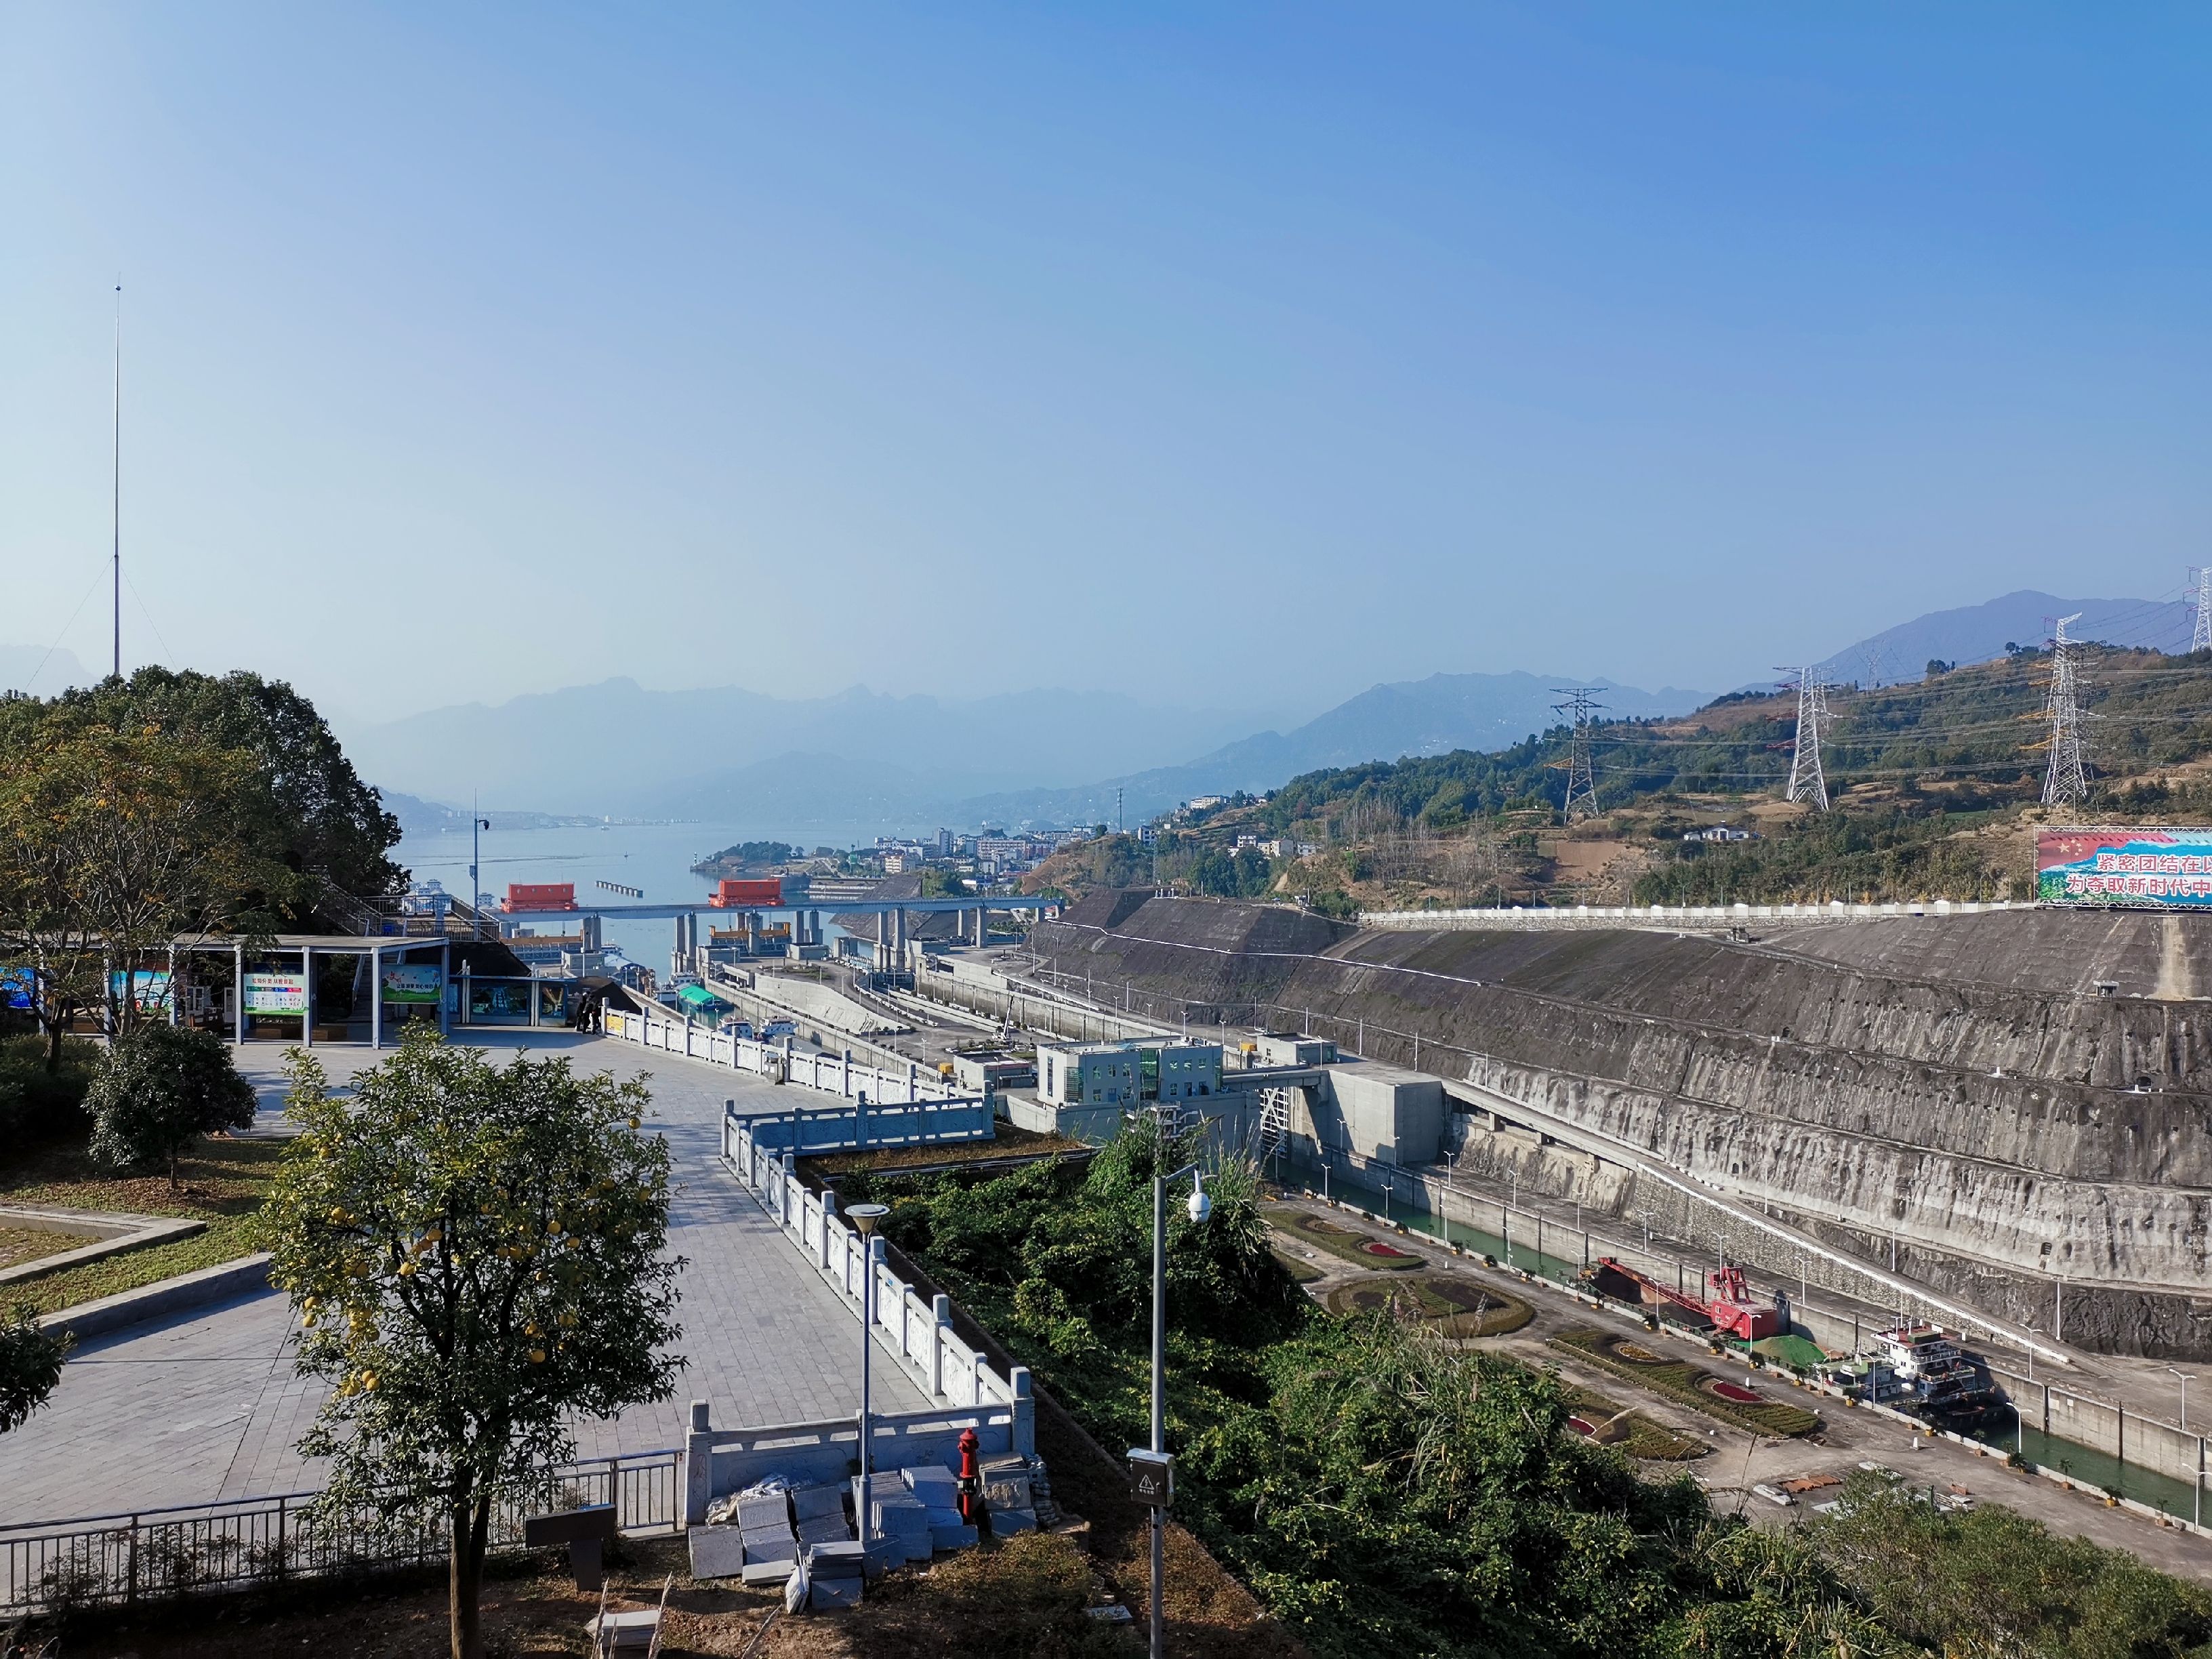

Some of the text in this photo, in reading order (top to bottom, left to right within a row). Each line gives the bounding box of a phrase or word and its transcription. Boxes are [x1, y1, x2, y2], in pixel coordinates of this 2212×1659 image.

[2067, 876, 2211, 896] 为夺取新时代中
